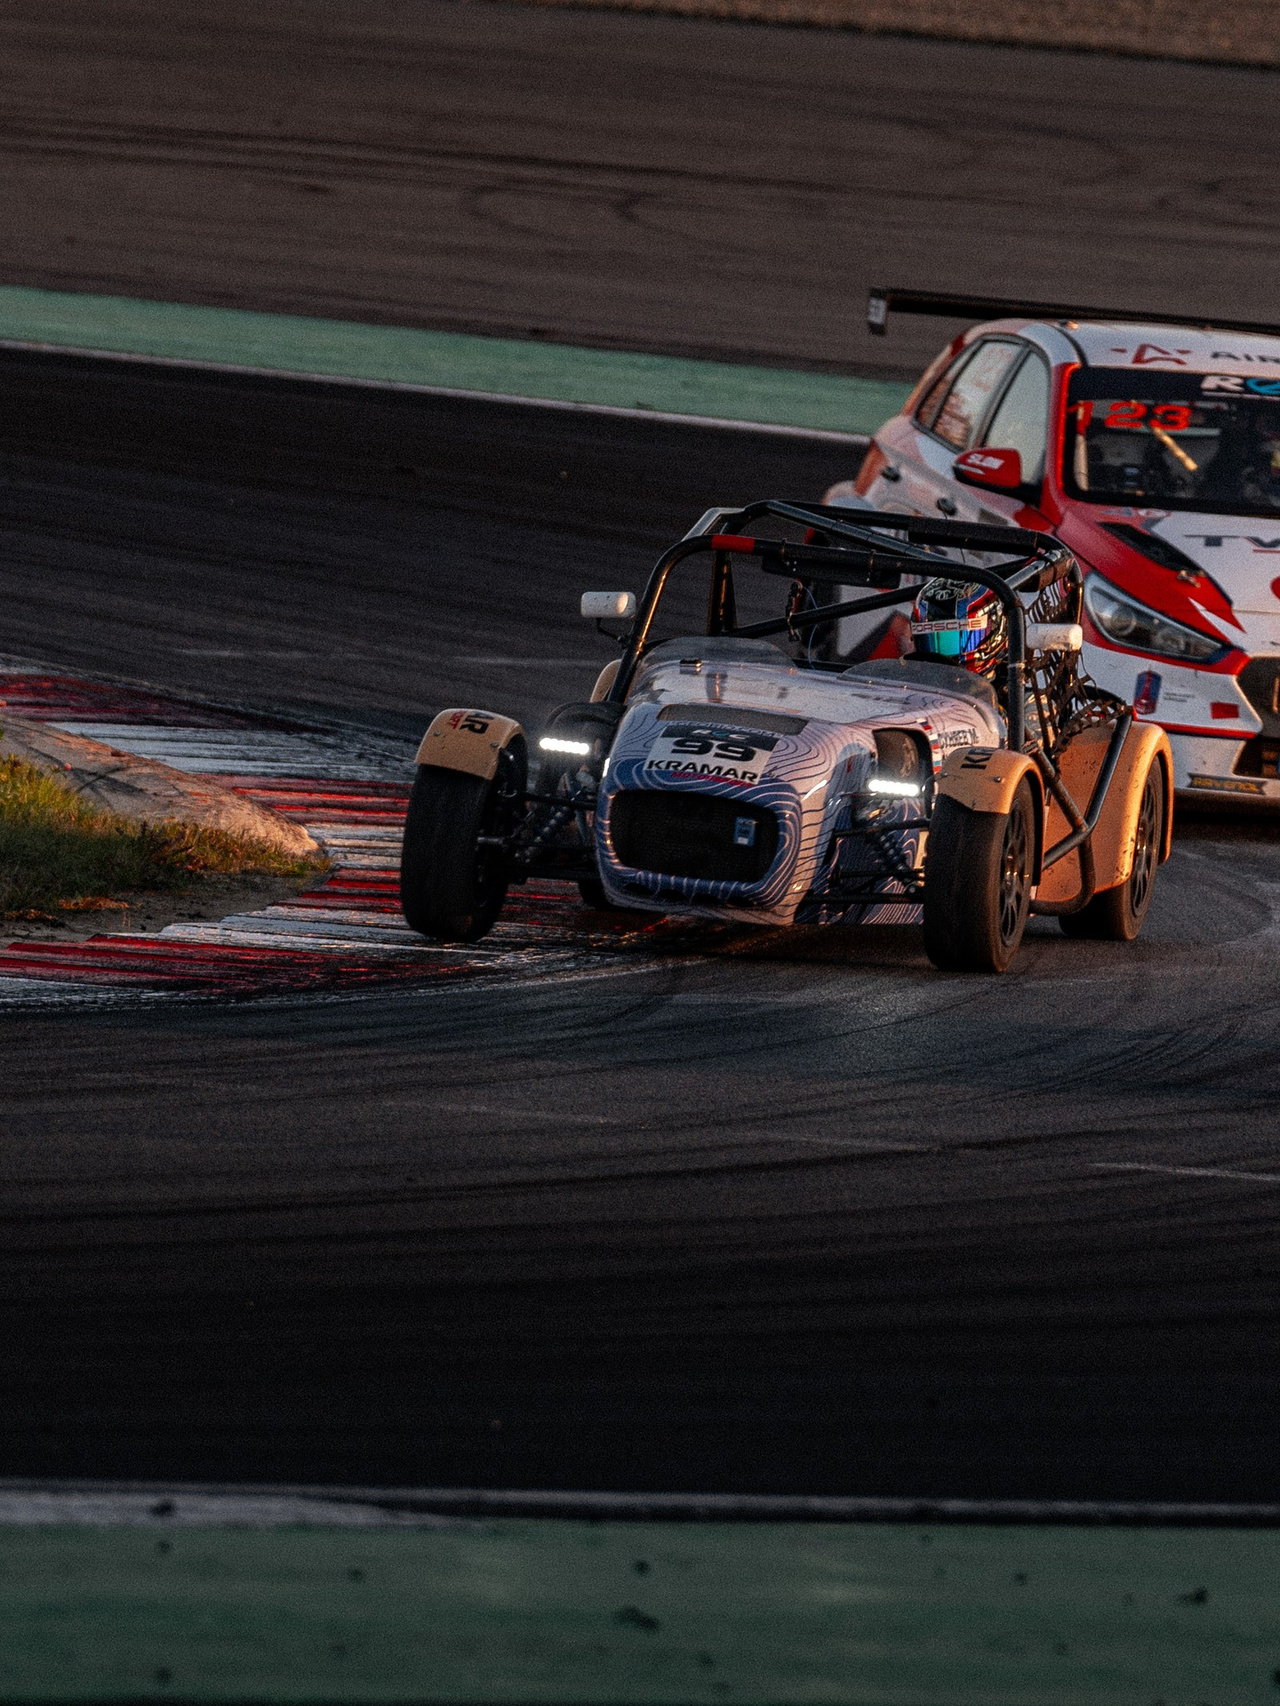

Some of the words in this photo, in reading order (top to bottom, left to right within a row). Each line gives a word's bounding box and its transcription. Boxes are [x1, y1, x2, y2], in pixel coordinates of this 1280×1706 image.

[1066, 400, 1192, 437] 123
[912, 619, 983, 633] PORSCHE
[671, 738, 757, 762] 99
[648, 760, 759, 783] KRAMAR
